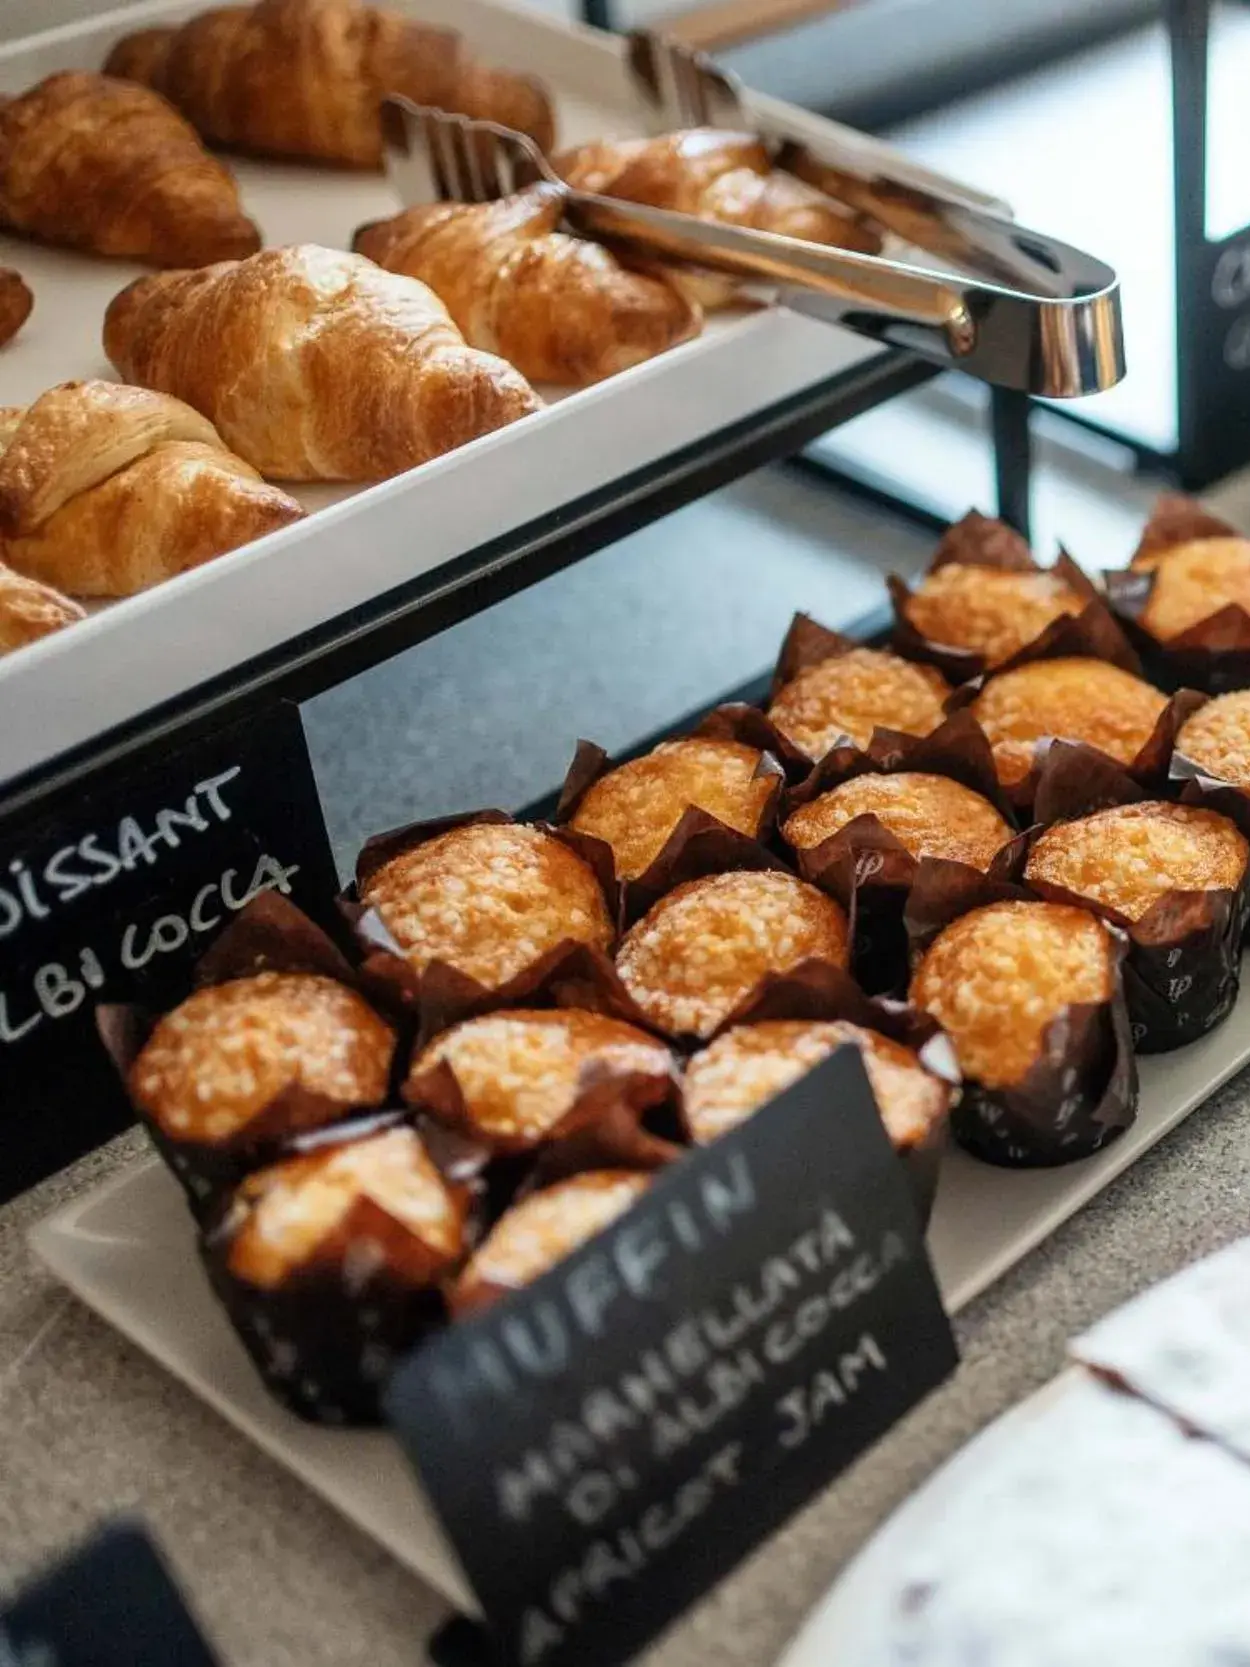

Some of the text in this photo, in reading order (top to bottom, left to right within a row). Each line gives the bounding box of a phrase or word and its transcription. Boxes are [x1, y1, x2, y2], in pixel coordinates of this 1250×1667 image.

[428, 1150, 757, 1415] MUFFIN
[520, 1331, 888, 1658] APRICOT JAM
